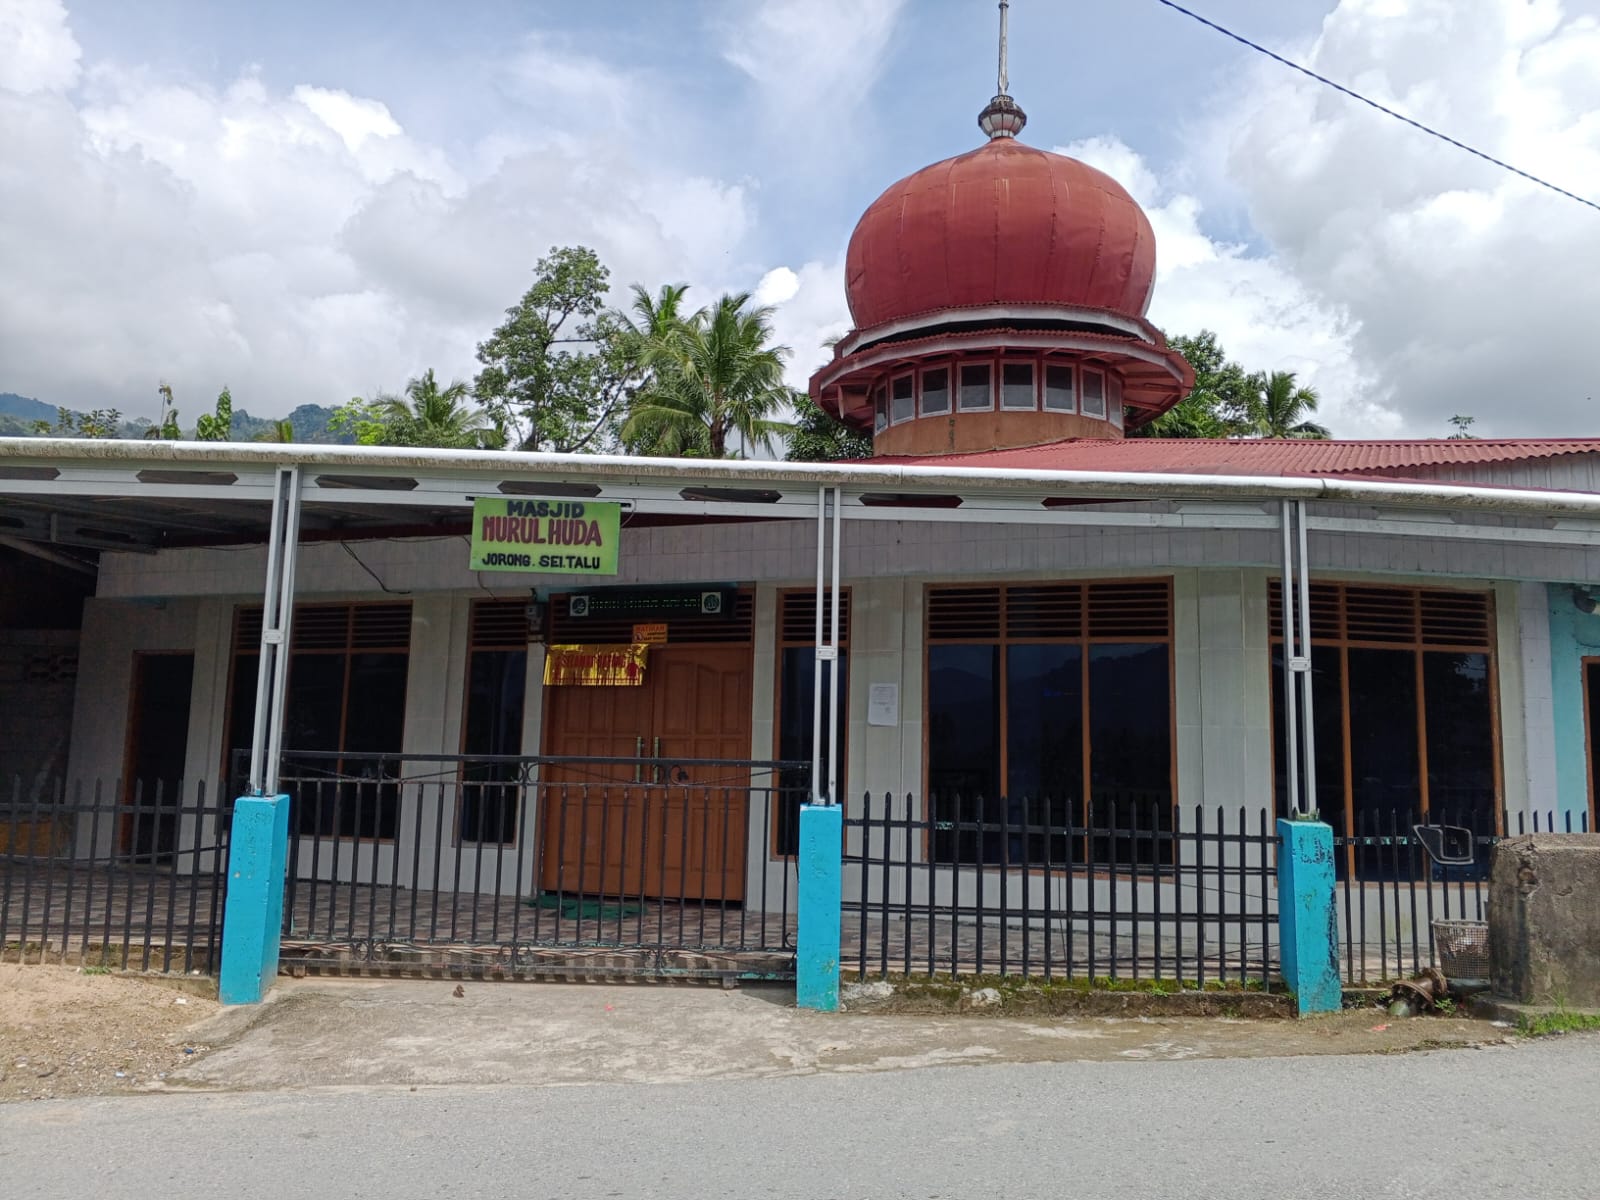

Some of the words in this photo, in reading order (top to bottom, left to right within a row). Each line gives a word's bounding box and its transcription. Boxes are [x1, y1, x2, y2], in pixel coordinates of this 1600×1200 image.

[507, 499, 585, 518] MASJID
[482, 516, 546, 544] NURUL
[548, 518, 602, 547] HUDA
